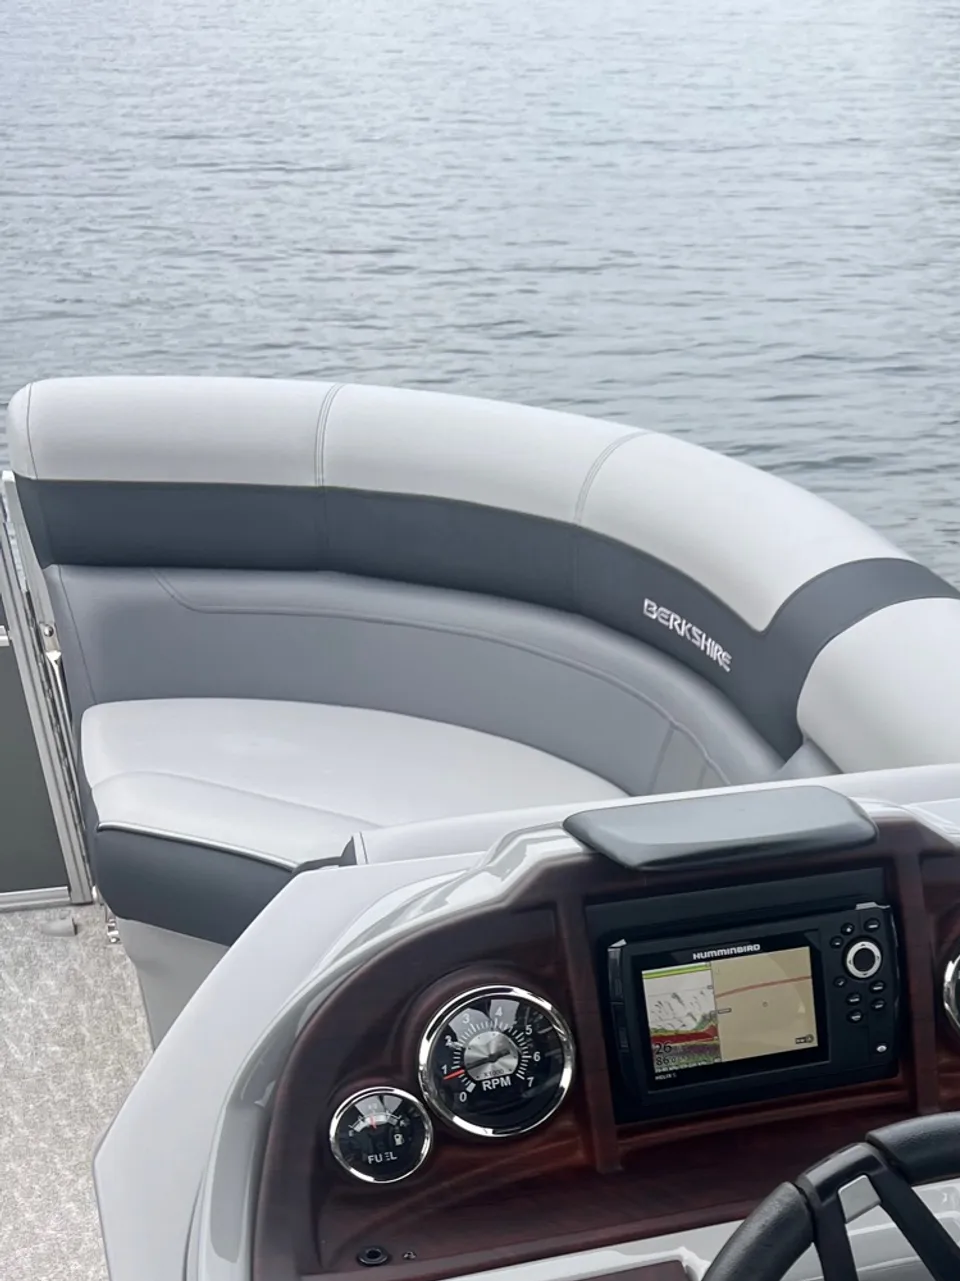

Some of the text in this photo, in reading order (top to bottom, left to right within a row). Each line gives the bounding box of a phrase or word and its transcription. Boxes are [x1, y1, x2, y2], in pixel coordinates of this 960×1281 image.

[643, 598, 732, 672] BERKSHIRE
[693, 943, 760, 960] HUMMINBIRD
[495, 1006, 503, 1017] 4
[462, 1013, 470, 1024] 3
[525, 1025, 532, 1035] 5
[533, 1051, 541, 1062] 6
[442, 1065, 447, 1074] 1
[482, 1076, 512, 1091] RPM
[527, 1077, 534, 1087] 7
[460, 1091, 467, 1102] 0
[368, 1151, 398, 1164] FUEL
